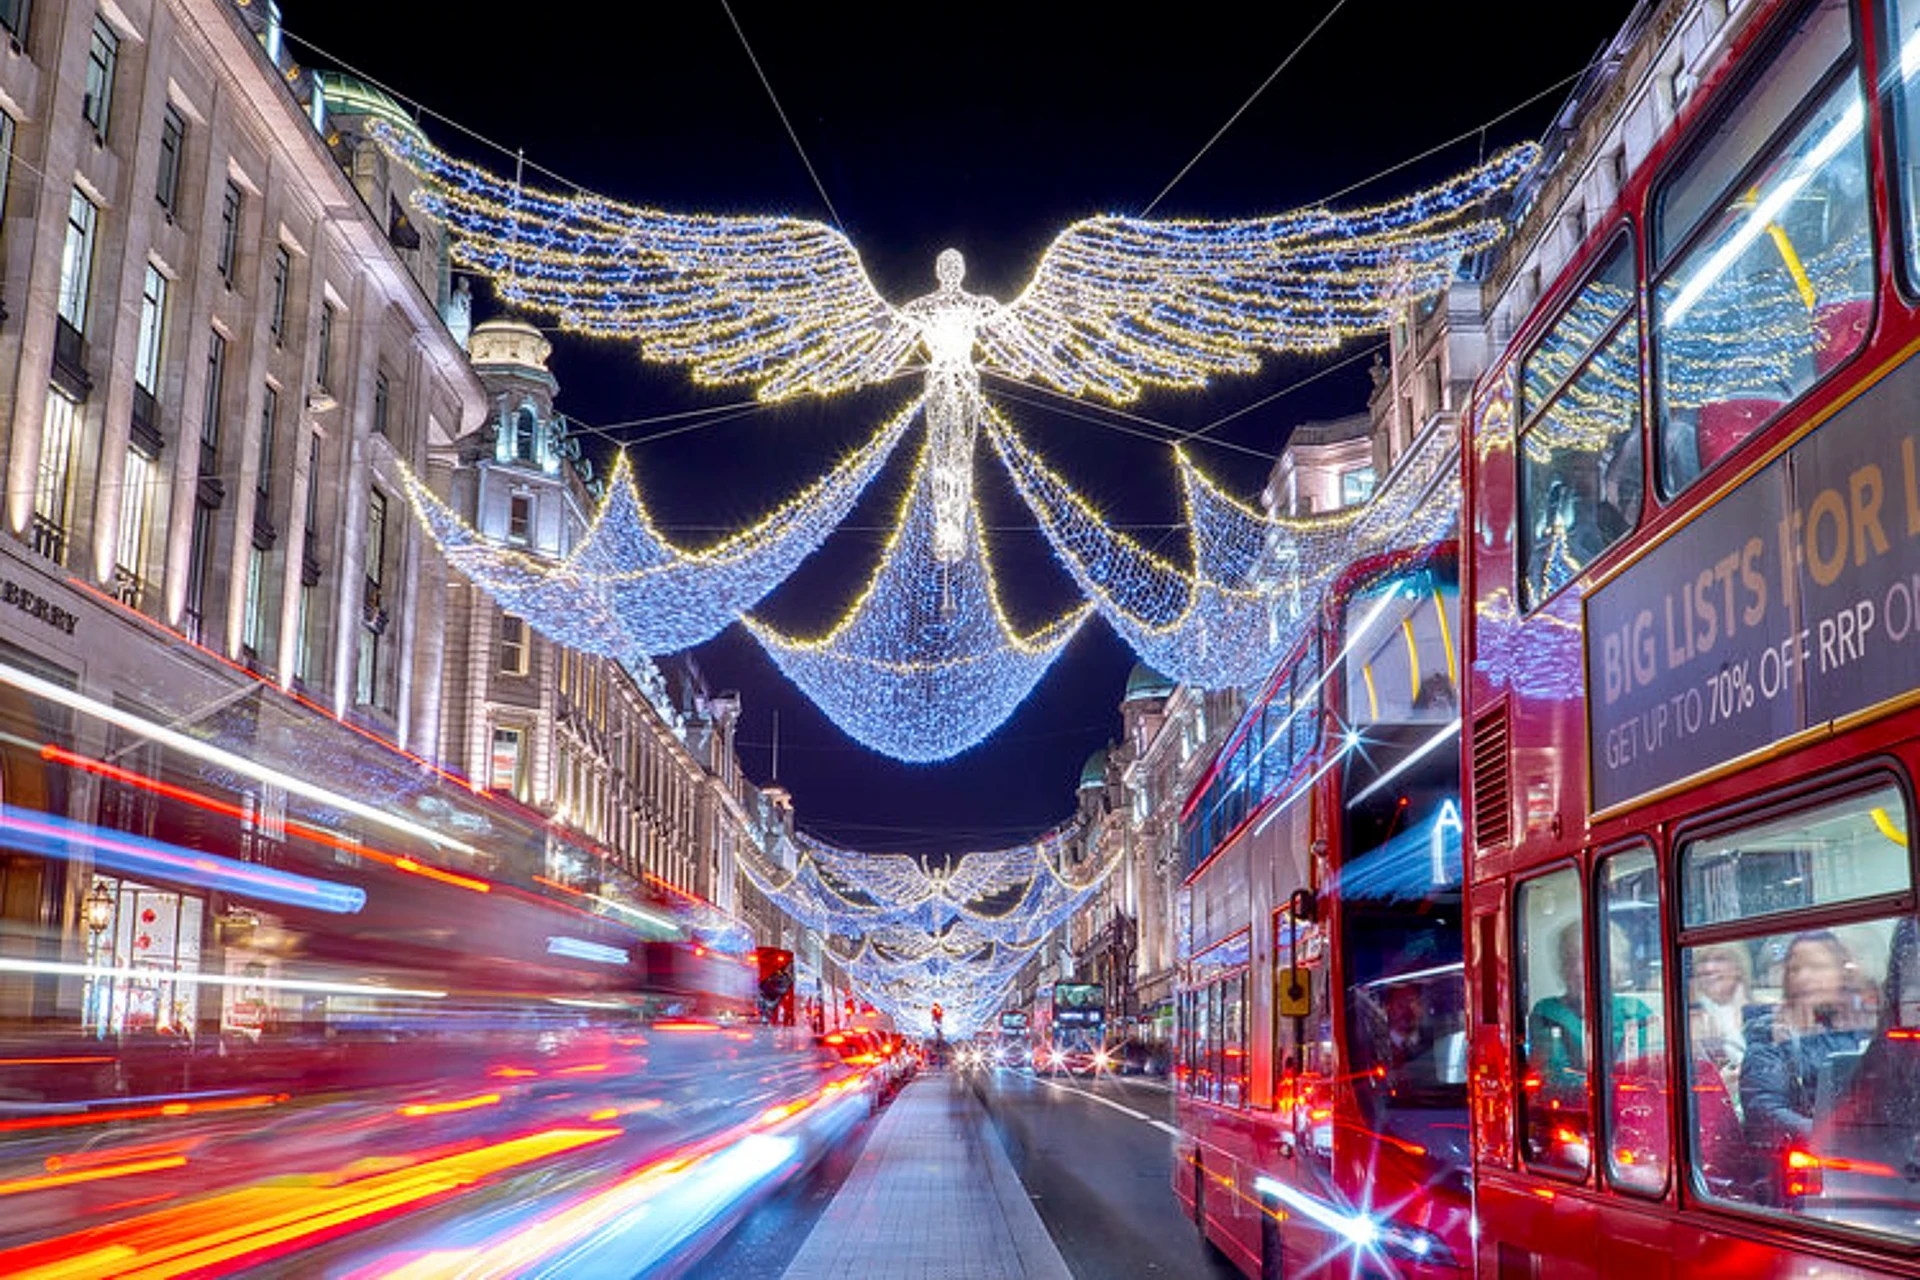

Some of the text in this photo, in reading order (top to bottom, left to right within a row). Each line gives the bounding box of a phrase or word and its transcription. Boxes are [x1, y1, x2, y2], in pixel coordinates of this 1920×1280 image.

[0, 578, 80, 635] BERRY
[1604, 611, 1656, 705] BIG
[1666, 537, 1768, 669] LISTS
[1778, 463, 1891, 607] FOR
[1606, 716, 1640, 769] GET
[1643, 703, 1668, 751] UP
[1672, 687, 1700, 738] TO
[1707, 660, 1754, 724] 70%
[1760, 628, 1811, 699] OFF
[1819, 600, 1876, 674] RRP
